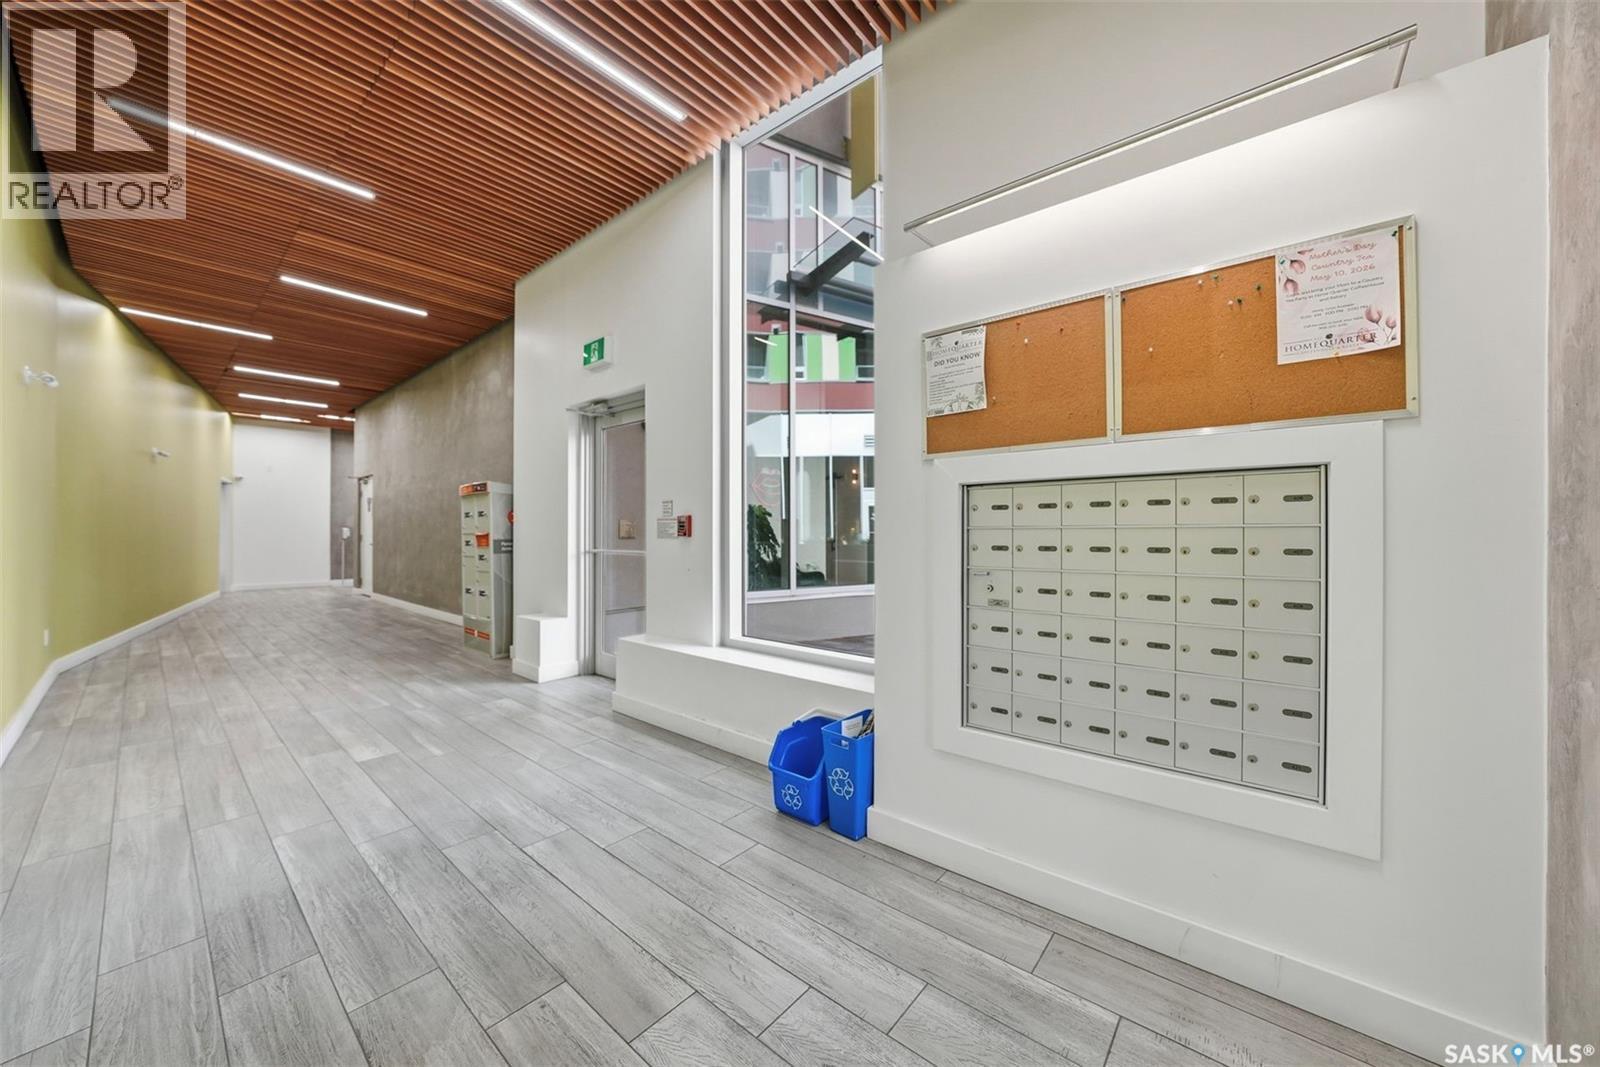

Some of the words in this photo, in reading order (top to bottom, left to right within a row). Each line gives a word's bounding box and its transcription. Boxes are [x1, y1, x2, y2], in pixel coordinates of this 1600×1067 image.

[1309, 247, 1352, 260] Mother's
[1352, 241, 1377, 251] Day
[1311, 259, 1354, 271] Country
[1356, 253, 1376, 261] Tea
[1310, 273, 1331, 282] May
[1350, 263, 1376, 274] 2026
[933, 359, 945, 368] DID
[946, 355, 960, 364] YOU
[960, 352, 980, 360] KNOW
